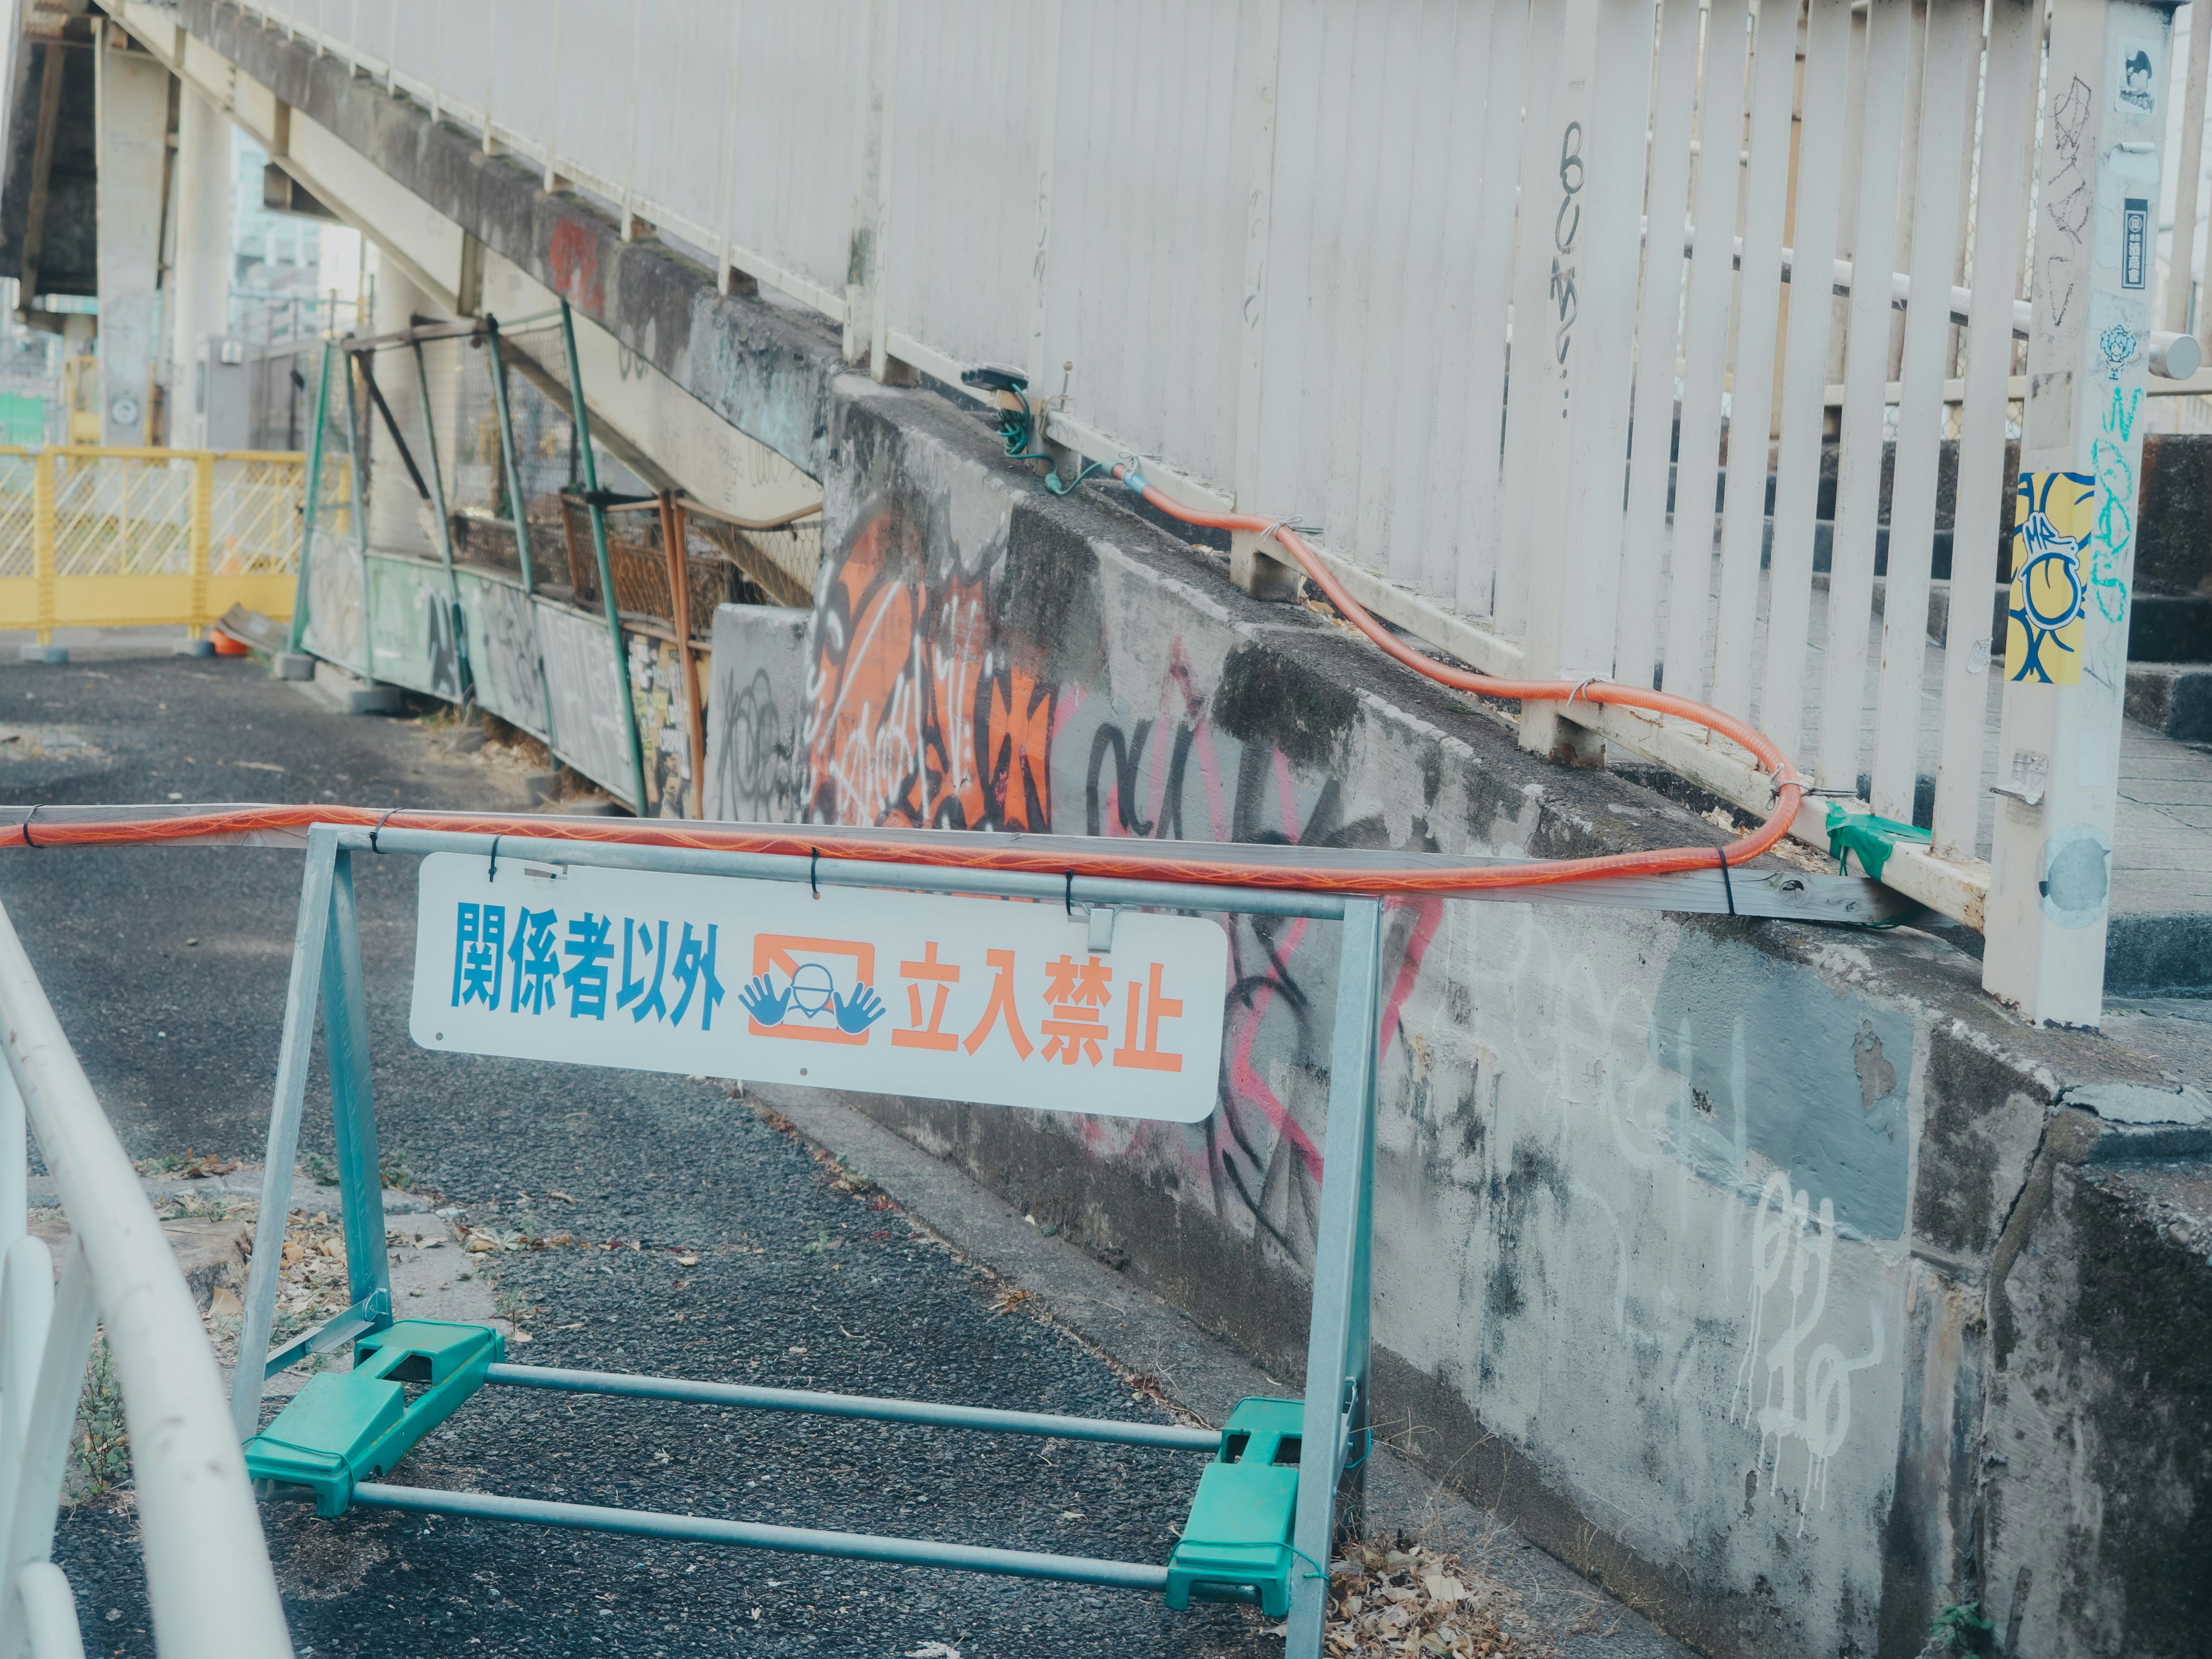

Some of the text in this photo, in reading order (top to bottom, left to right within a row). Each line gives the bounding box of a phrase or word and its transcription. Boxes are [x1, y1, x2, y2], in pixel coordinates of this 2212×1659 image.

[451, 901, 1183, 1072] 関係者以外 立入禁止
